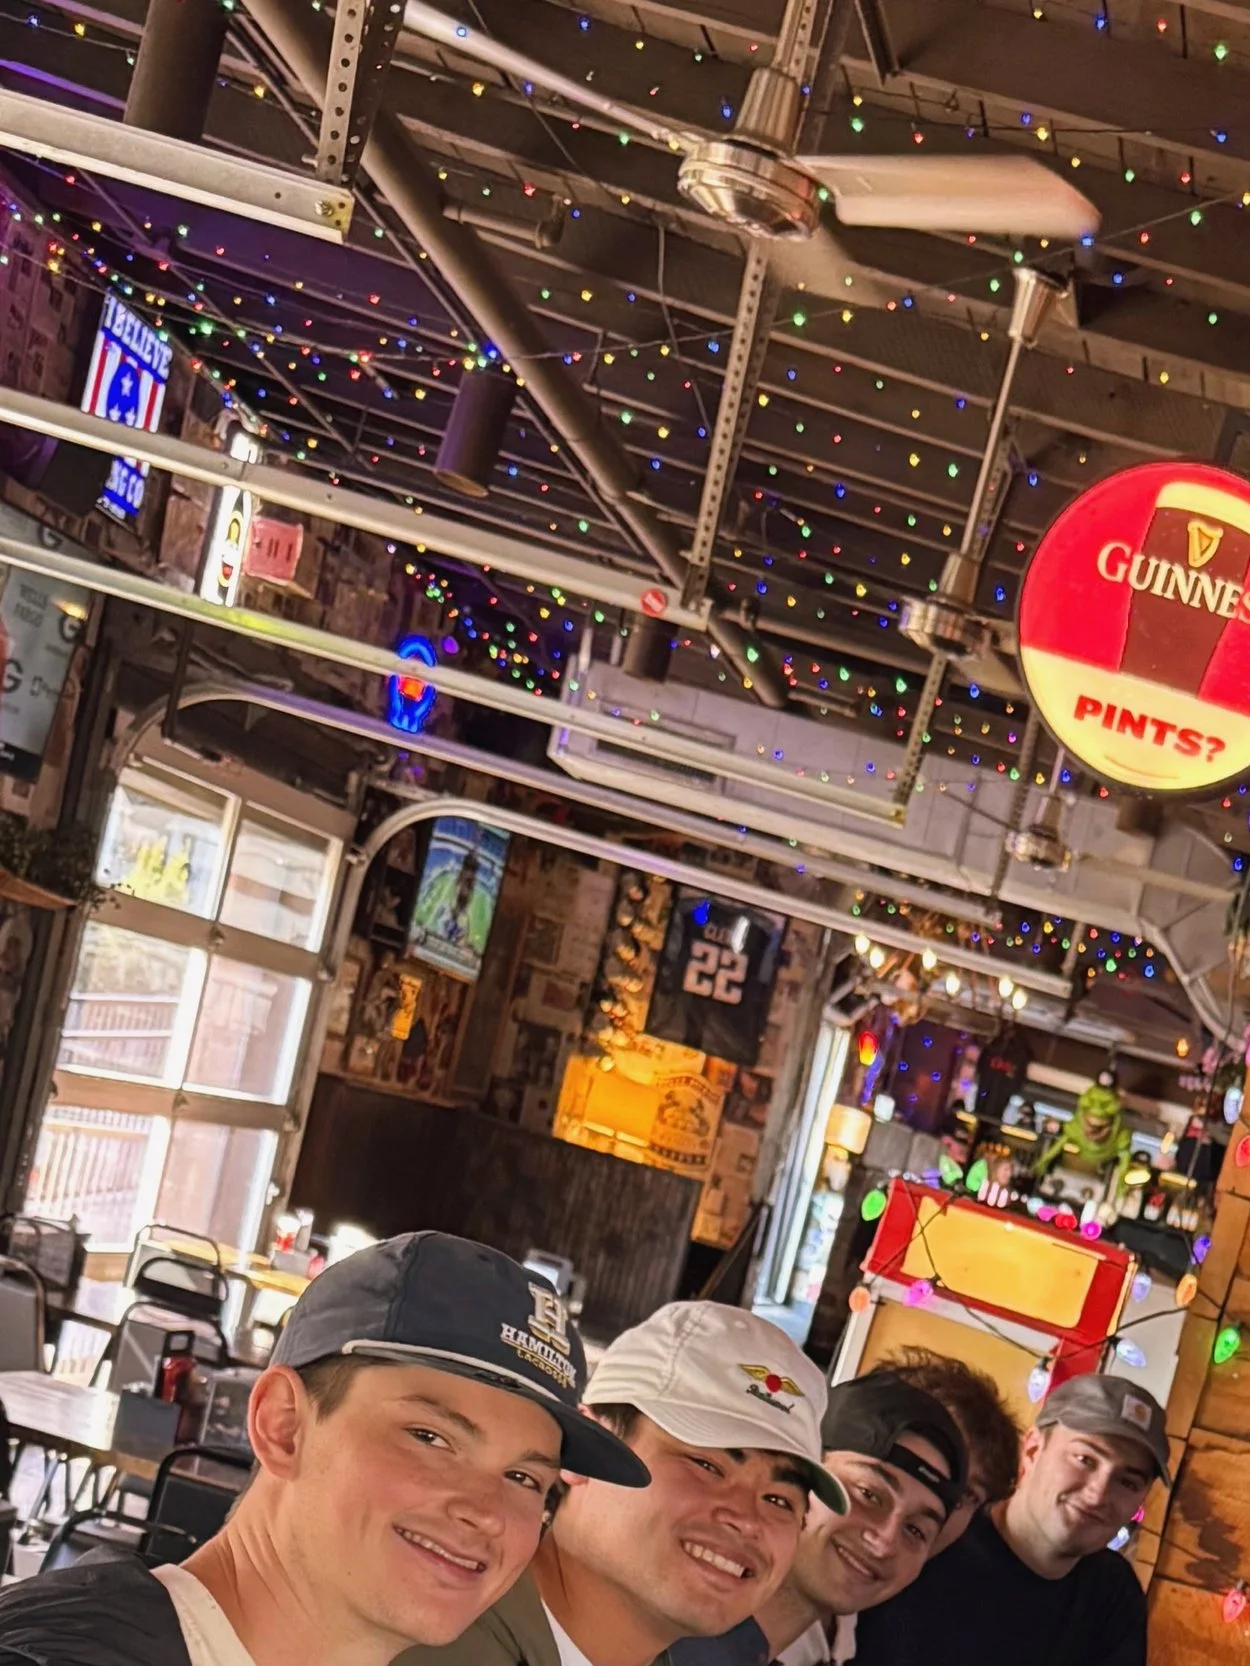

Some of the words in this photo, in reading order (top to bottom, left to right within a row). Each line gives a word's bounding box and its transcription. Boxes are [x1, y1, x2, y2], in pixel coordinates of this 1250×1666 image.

[1073, 695, 1227, 763] PINTS?
[683, 940, 749, 1005] 22
[500, 1322, 577, 1389] HAMILTON
